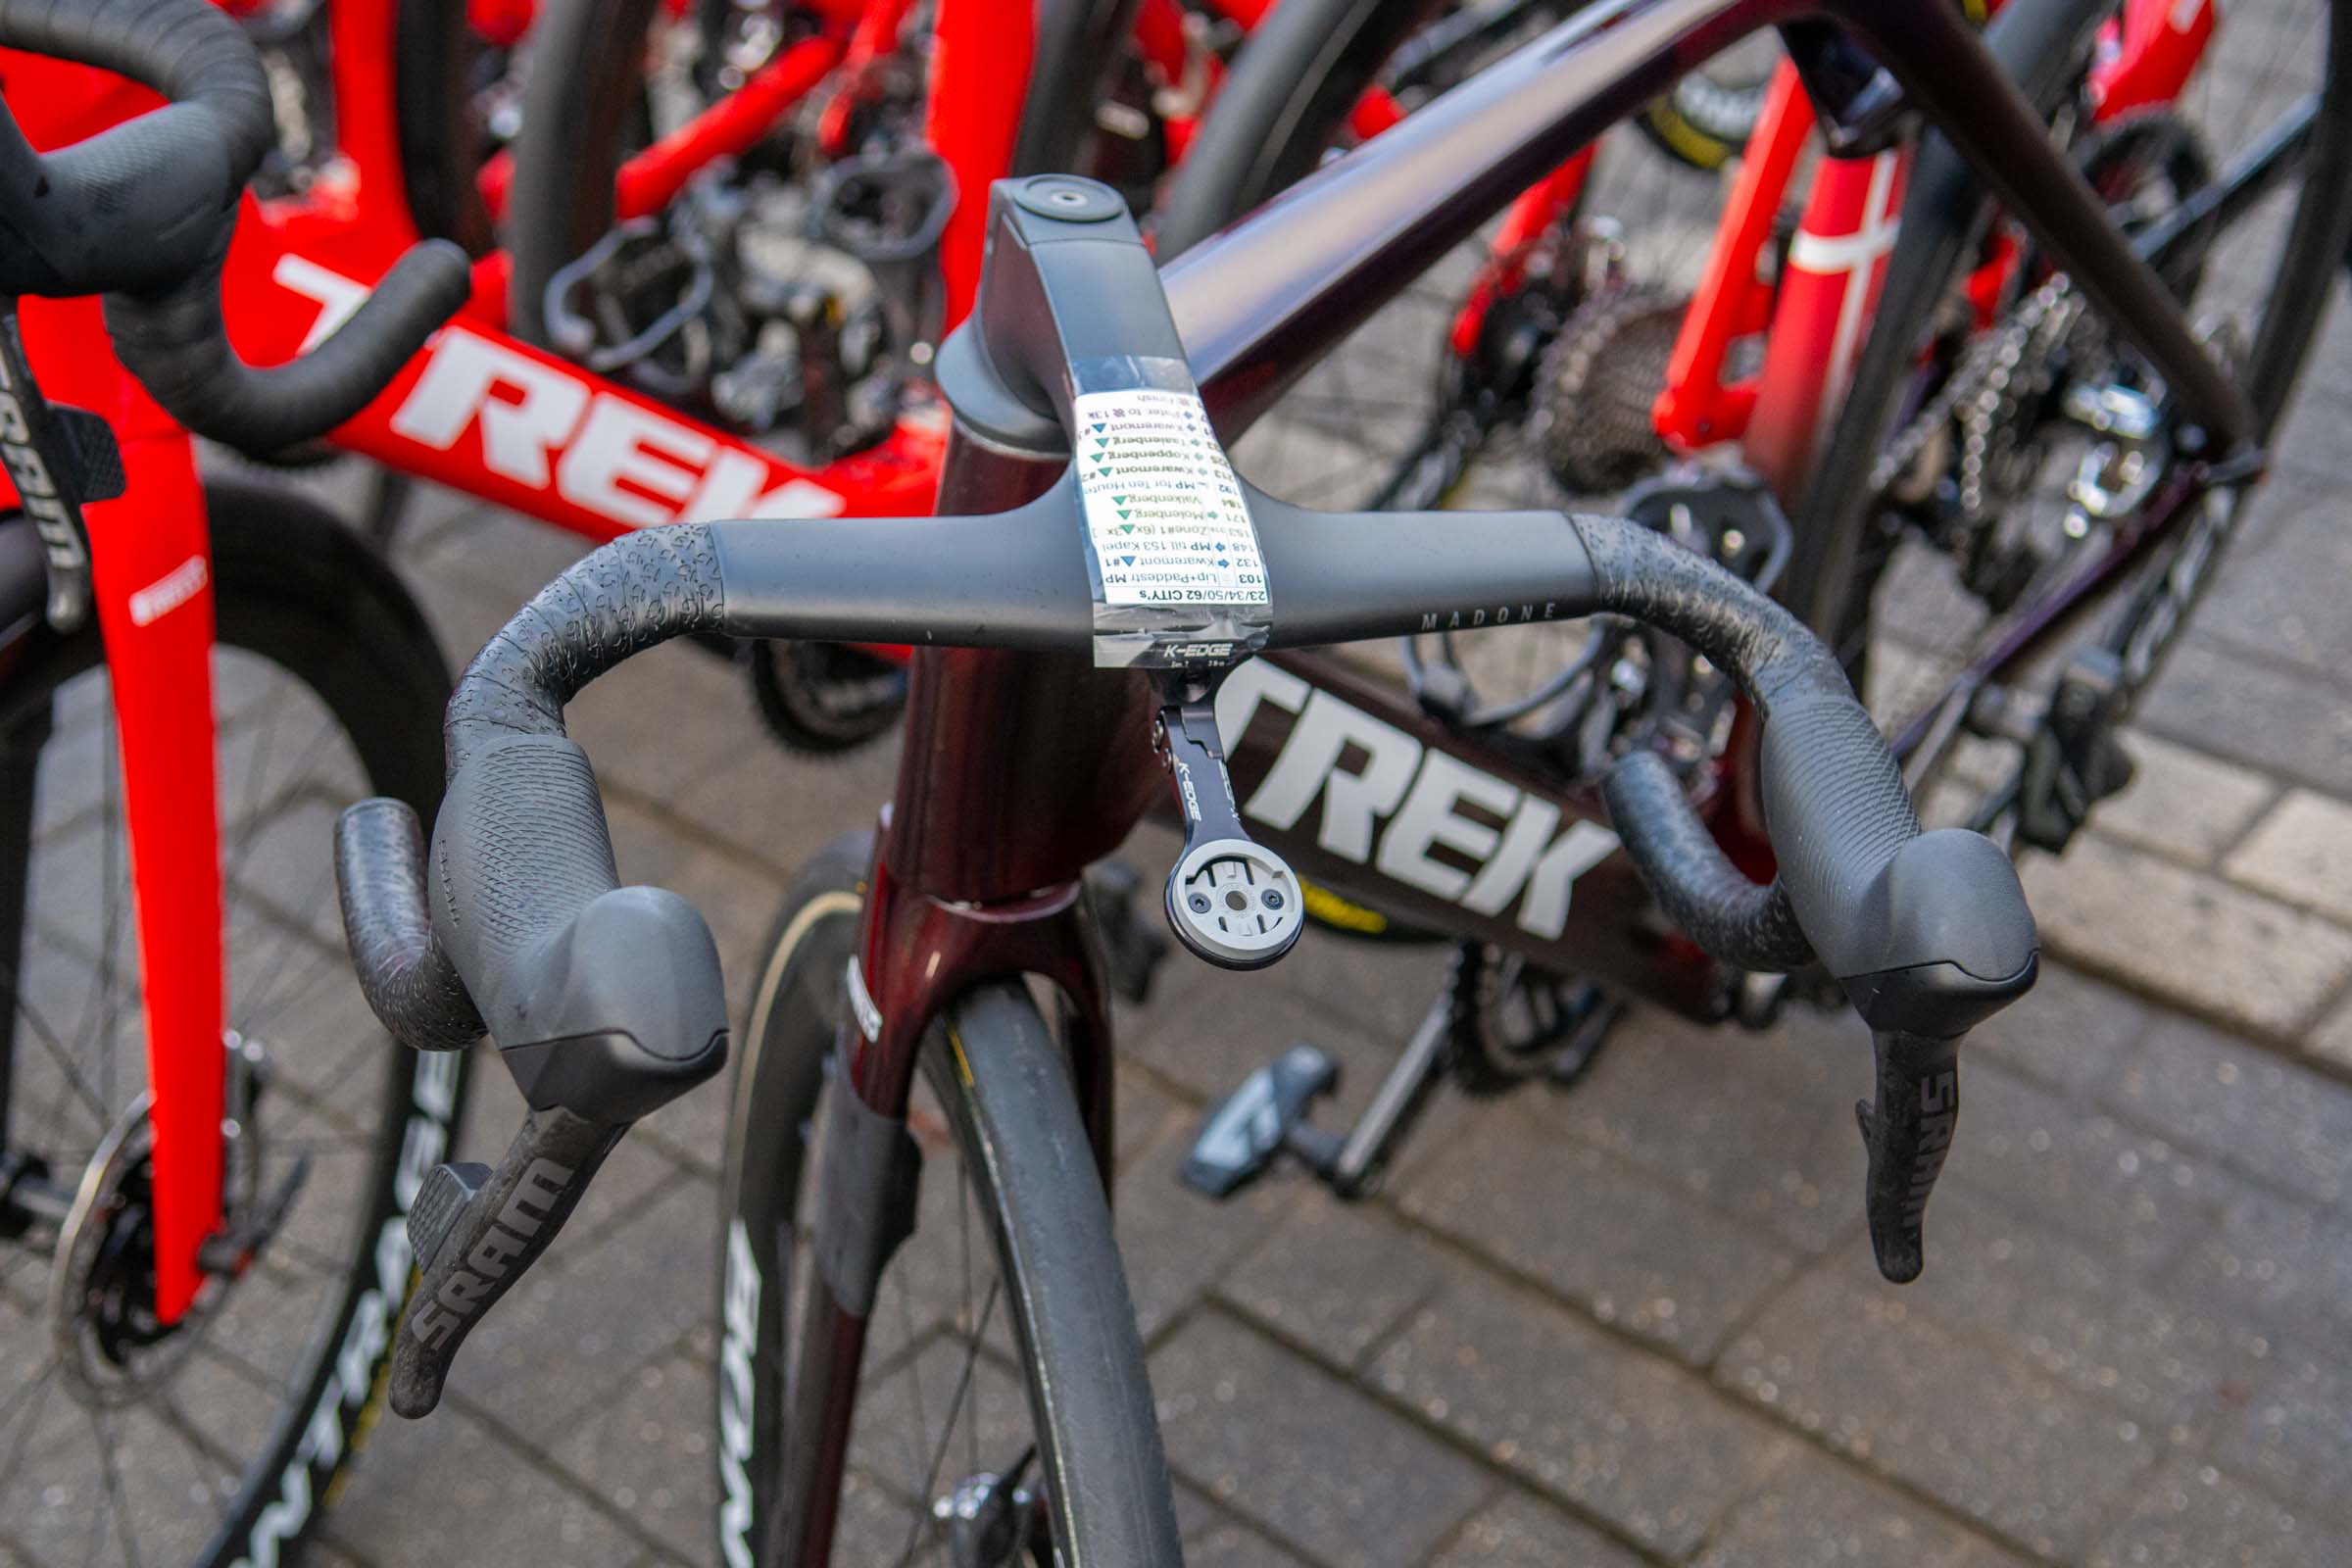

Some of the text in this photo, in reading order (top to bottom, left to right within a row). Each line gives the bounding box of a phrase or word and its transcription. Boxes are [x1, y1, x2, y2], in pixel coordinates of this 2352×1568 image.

[1110, 422, 1184, 431] Kwaremont
[1107, 451, 1190, 461] Koppenberg
[1115, 466, 1193, 475] Kwaremont
[1176, 480, 1196, 489] MP
[1129, 494, 1201, 505] Valkenberg
[1135, 509, 1246, 523] 171 Molenberg
[1143, 541, 1166, 551] 153
[1172, 542, 1187, 551] till
[1191, 542, 1211, 551] MP
[1141, 557, 1214, 566] Kwaremont
[1237, 559, 1258, 567] 132
[1105, 573, 1126, 583] MP
[1239, 574, 1262, 584] 103
[1139, 590, 1265, 601] 23/34/50/62 CITY's
[1421, 602, 1555, 631] MADONE
[1163, 643, 1233, 658] K-EDGE
[1178, 762, 1202, 822] K-EDGE
[1901, 1070, 1956, 1227] SRAM
[412, 1157, 575, 1351] SRAM
